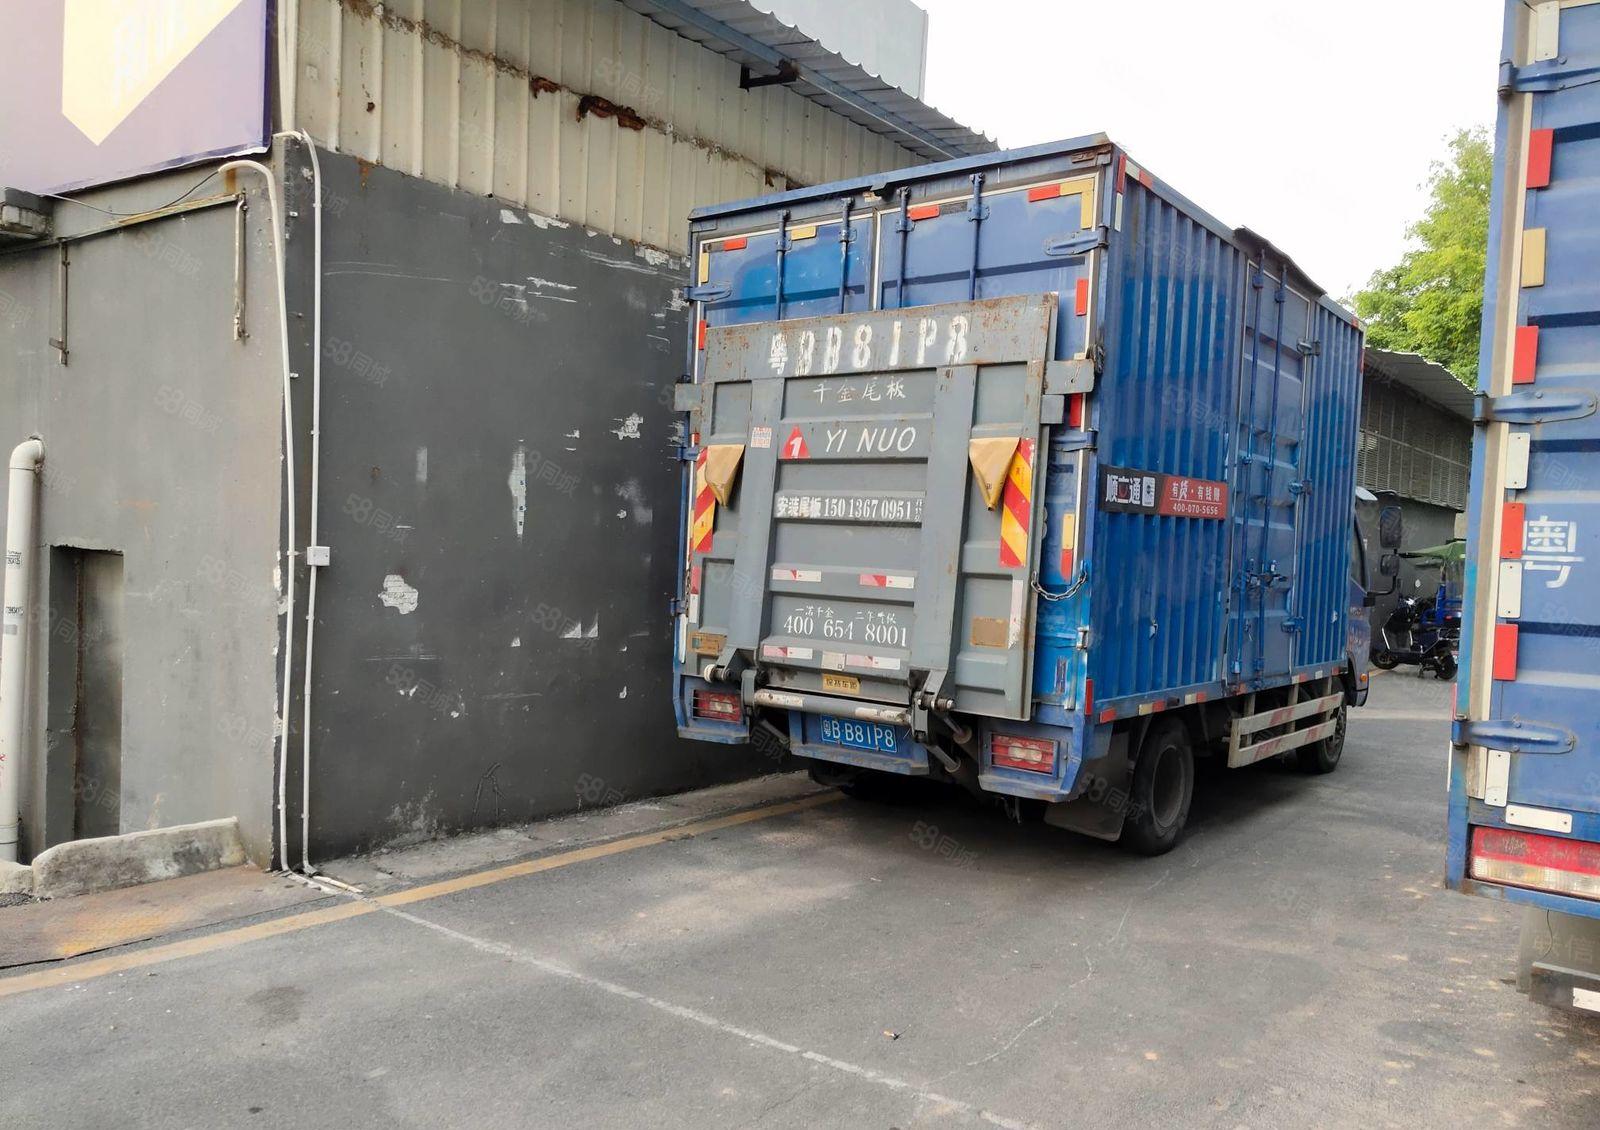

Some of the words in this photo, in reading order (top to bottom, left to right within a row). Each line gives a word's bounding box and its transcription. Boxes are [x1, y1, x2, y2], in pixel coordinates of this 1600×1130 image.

[813, 376, 907, 404] 千金尾板
[824, 428, 847, 453] YI
[857, 427, 917, 452] NUO
[824, 498, 846, 517] 150
[849, 499, 879, 518] 1367
[881, 500, 911, 519] 0951
[1521, 515, 1585, 588] 粤
[784, 615, 814, 636] 400
[823, 619, 854, 640] 654
[865, 623, 907, 647] 8001
